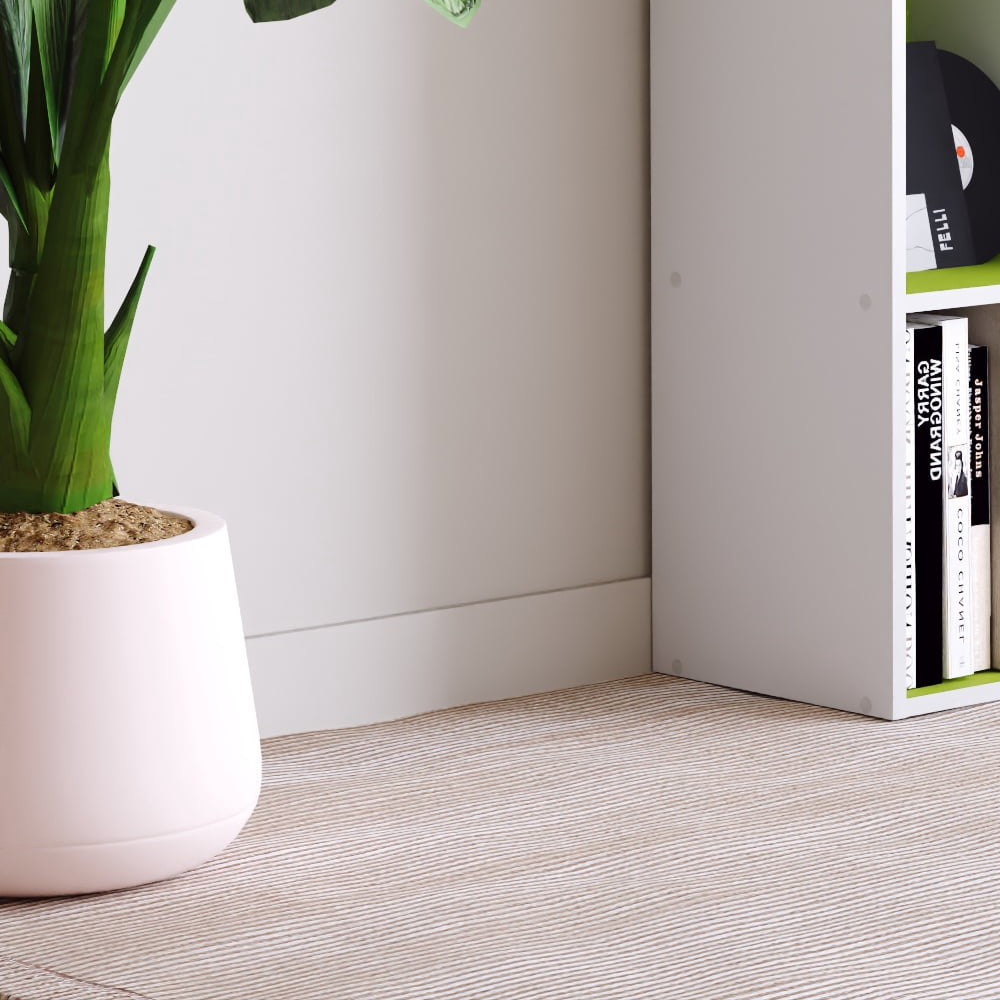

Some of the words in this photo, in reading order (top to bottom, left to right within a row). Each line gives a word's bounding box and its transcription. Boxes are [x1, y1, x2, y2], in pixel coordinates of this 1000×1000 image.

[932, 208, 954, 252] FELLI
[973, 378, 984, 430] Jasper
[973, 434, 984, 478] Johns
